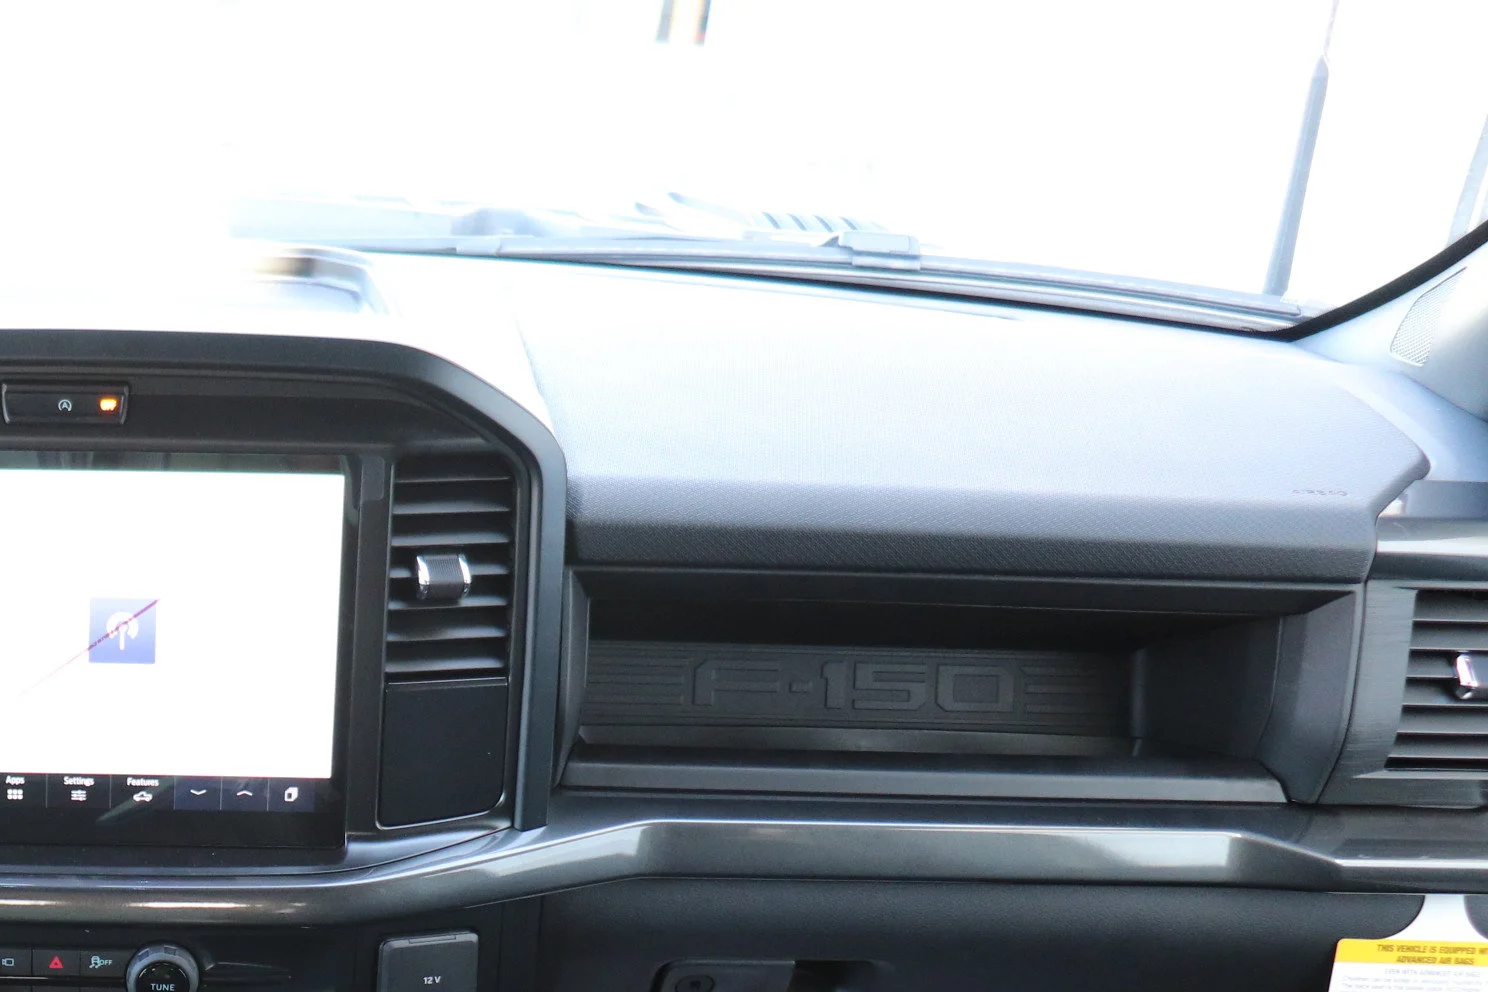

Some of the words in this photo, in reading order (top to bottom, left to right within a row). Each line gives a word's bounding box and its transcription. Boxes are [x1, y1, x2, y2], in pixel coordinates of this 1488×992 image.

[5, 775, 25, 786] Apps
[63, 776, 95, 787] Settings
[126, 776, 160, 787] Features
[1377, 944, 1394, 953] THIS
[1397, 945, 1428, 954] VEHICLE
[1429, 946, 1437, 954] IS
[1439, 947, 1477, 955] EQUIPPED
[1396, 955, 1437, 964] ADVANCED
[1454, 957, 1475, 965] BAGS
[423, 976, 433, 984] 12
[151, 983, 175, 992] TUNE
